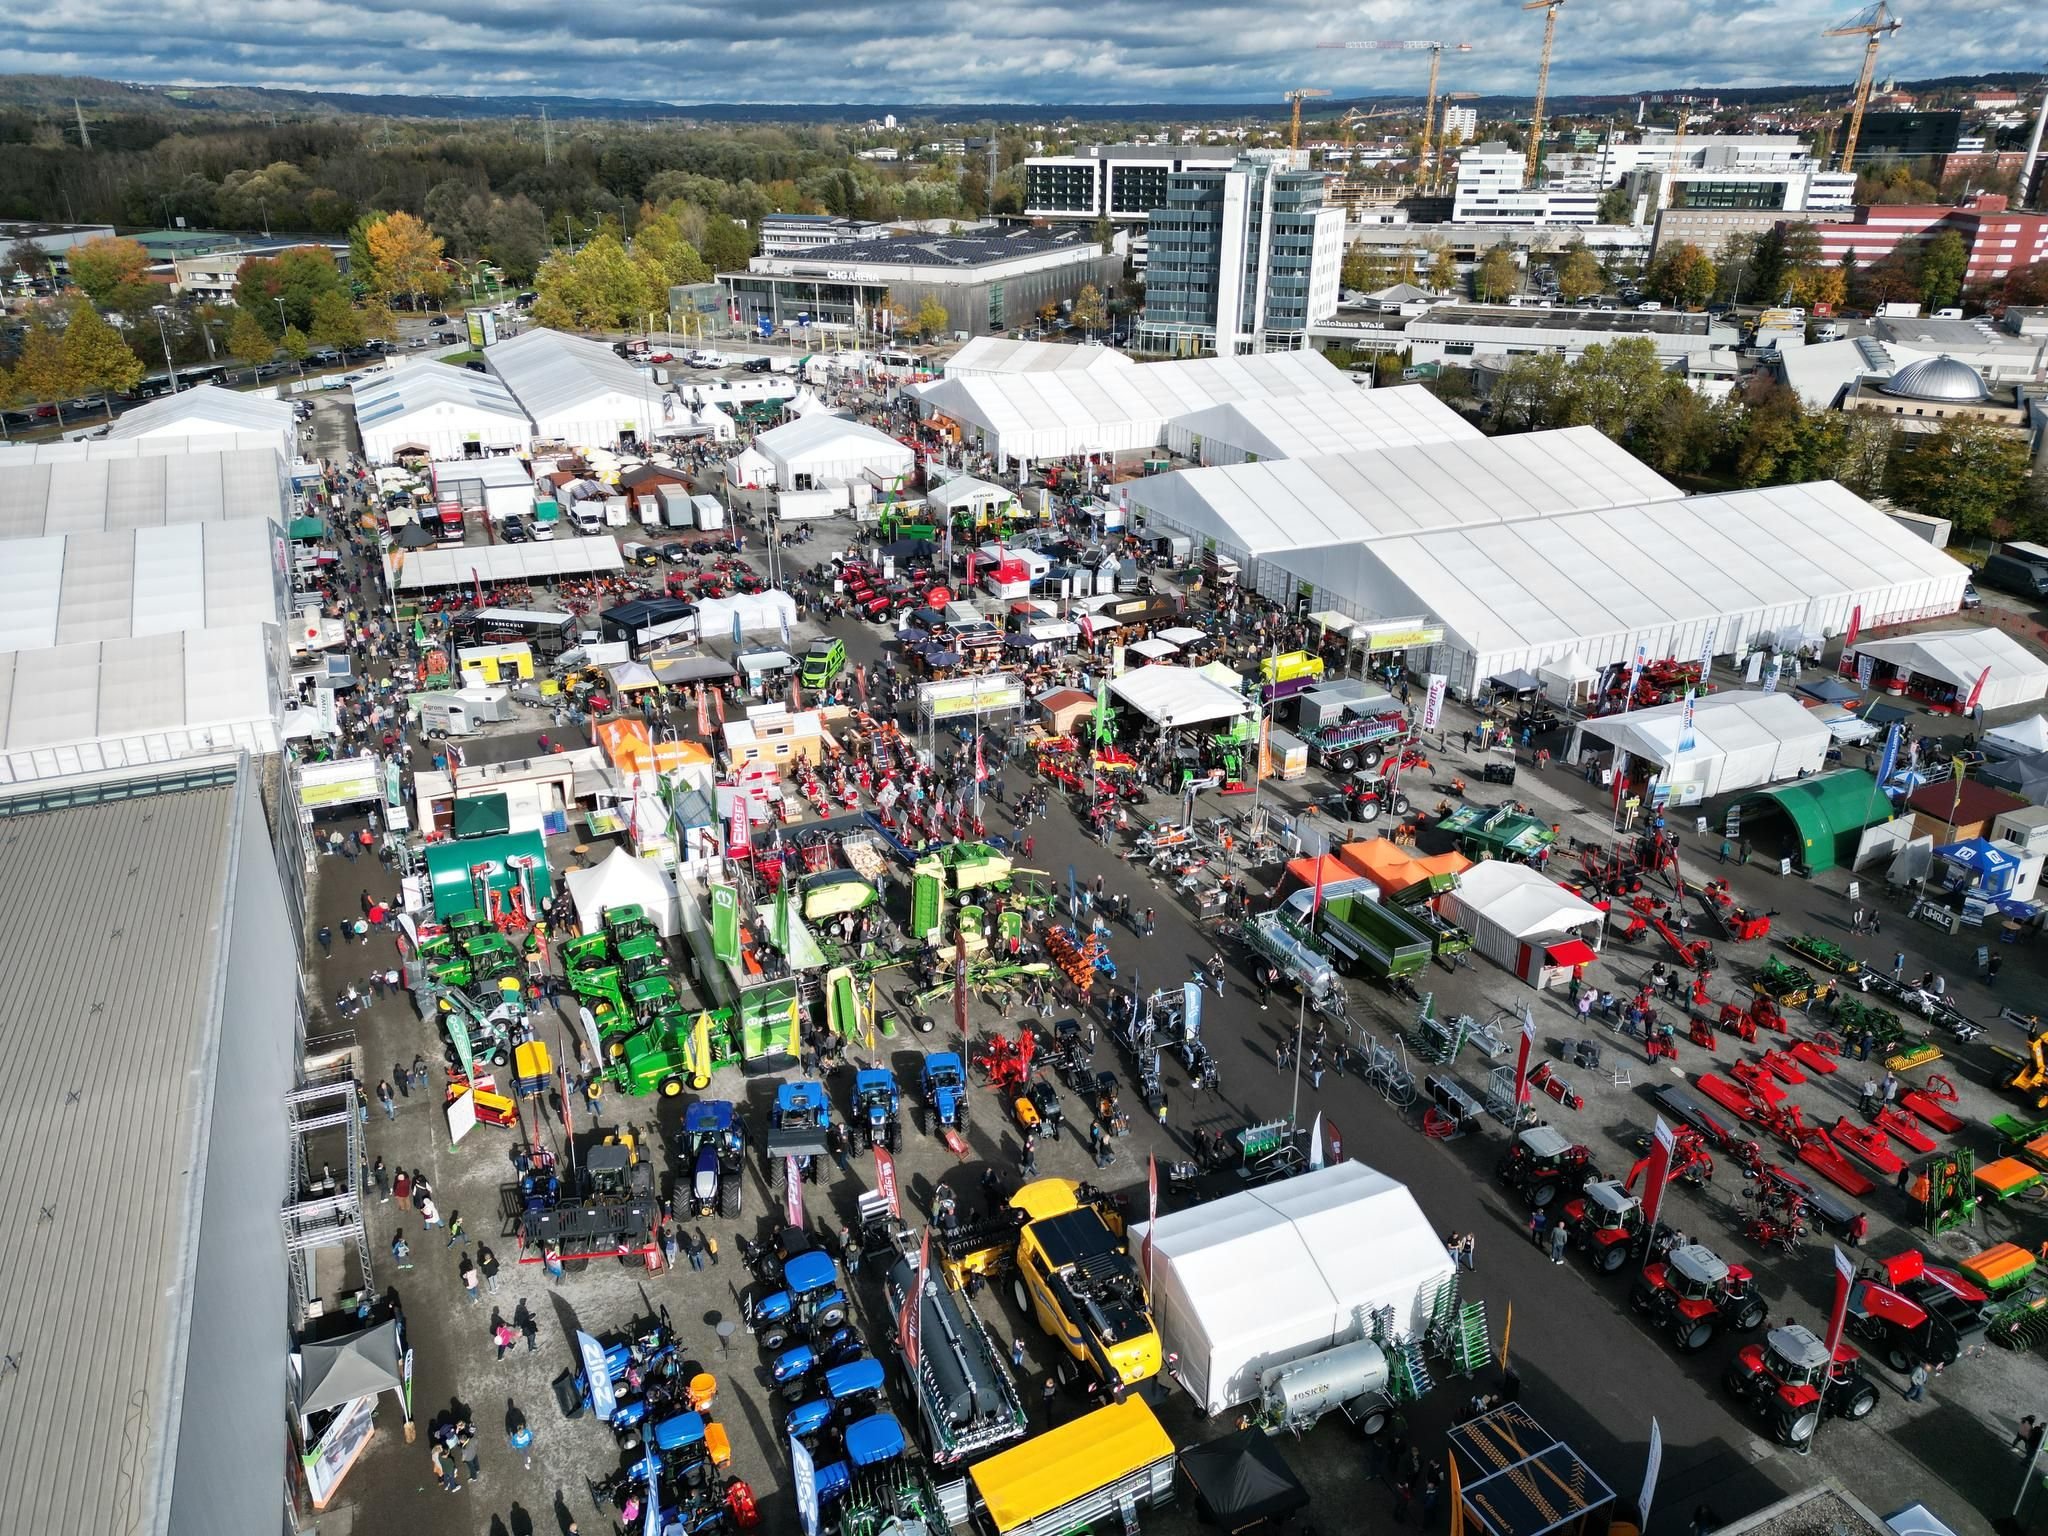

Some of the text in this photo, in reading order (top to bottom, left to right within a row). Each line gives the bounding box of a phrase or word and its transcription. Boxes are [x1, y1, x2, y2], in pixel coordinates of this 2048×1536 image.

[827, 270, 880, 282] CHG ARENA
[1313, 319, 1385, 329] Autohaus Wald
[1425, 685, 1439, 726] garant
[733, 801, 747, 844] ENGEL
